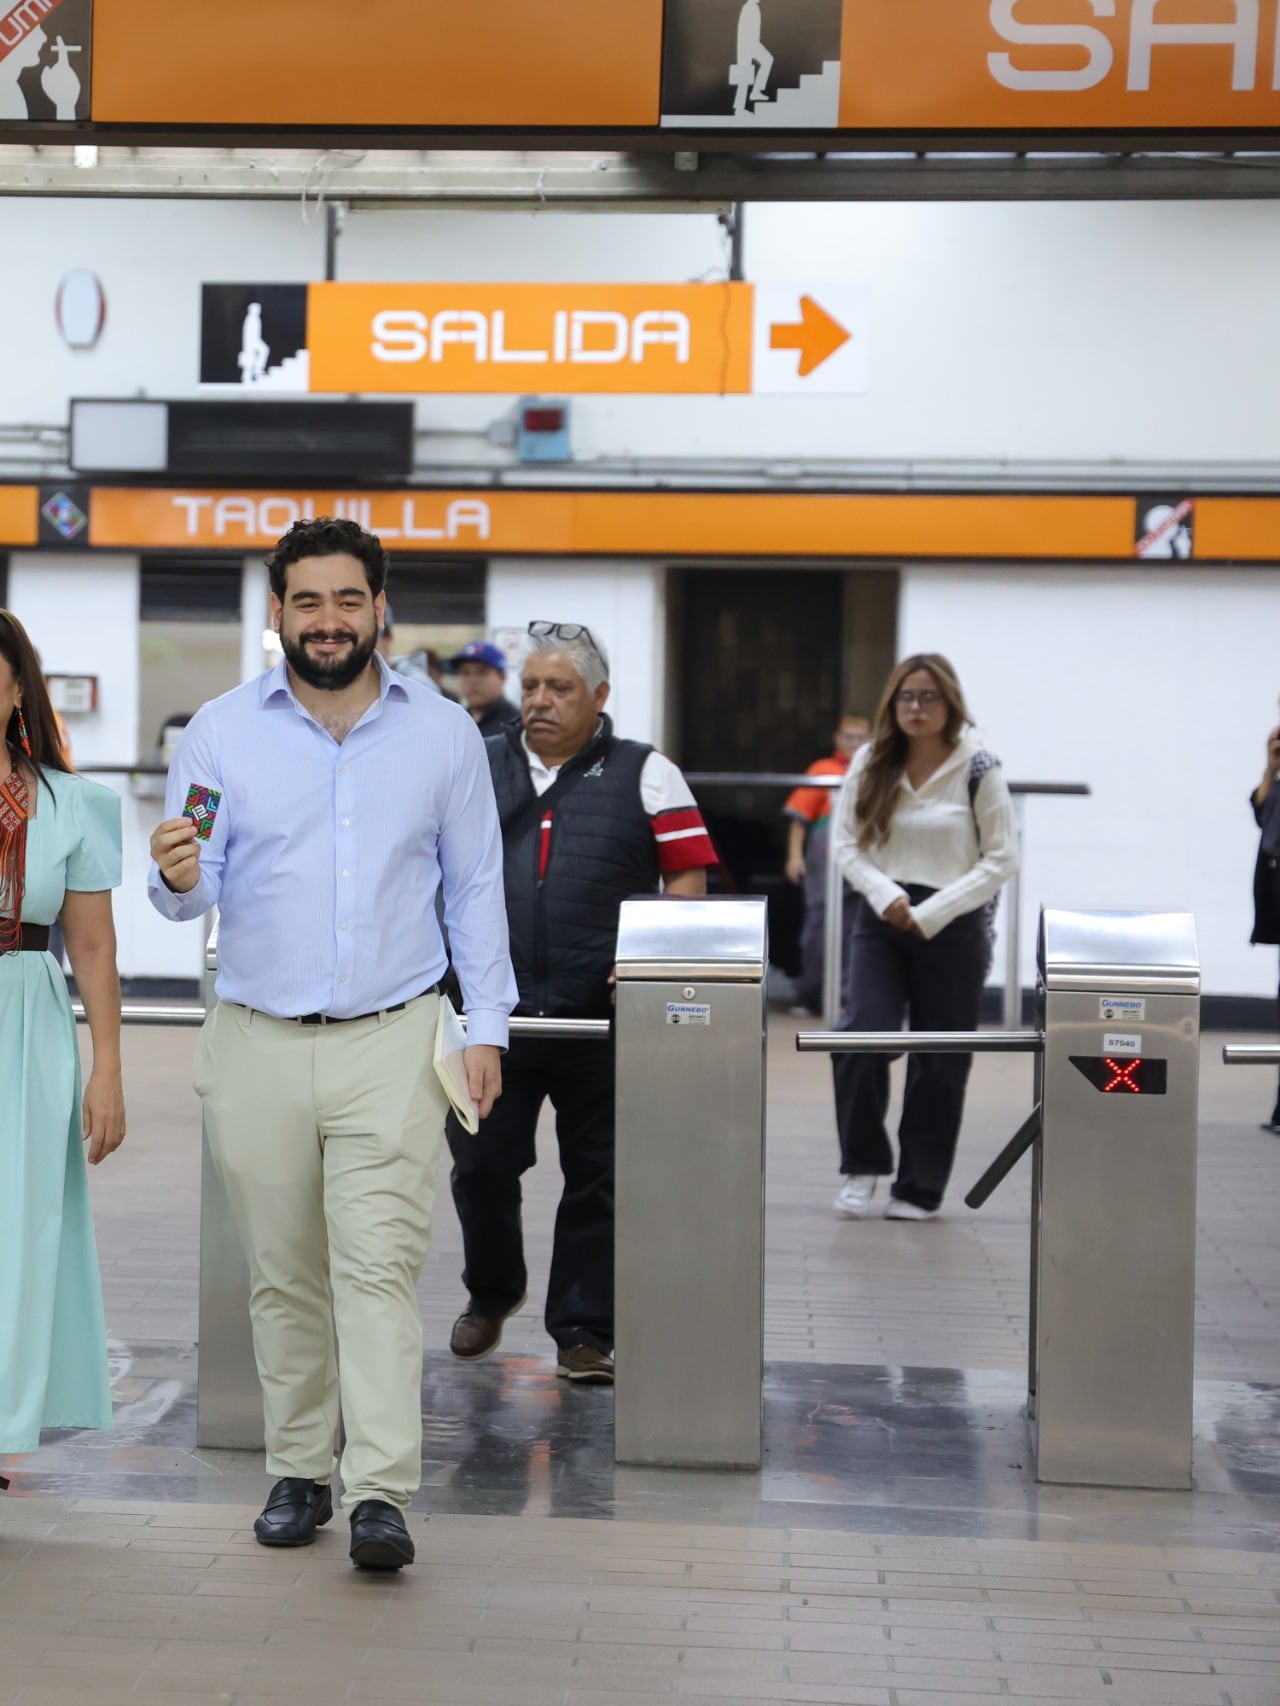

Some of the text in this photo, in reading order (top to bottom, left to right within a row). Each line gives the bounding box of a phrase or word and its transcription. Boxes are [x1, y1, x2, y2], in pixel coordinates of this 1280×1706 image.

[987, 0, 1280, 92] SA
[370, 310, 690, 364] SALIDA
[172, 495, 491, 540] TAQUILLA
[667, 1004, 708, 1013] GUNNEBO
[1101, 999, 1141, 1009] GUNNEBO
